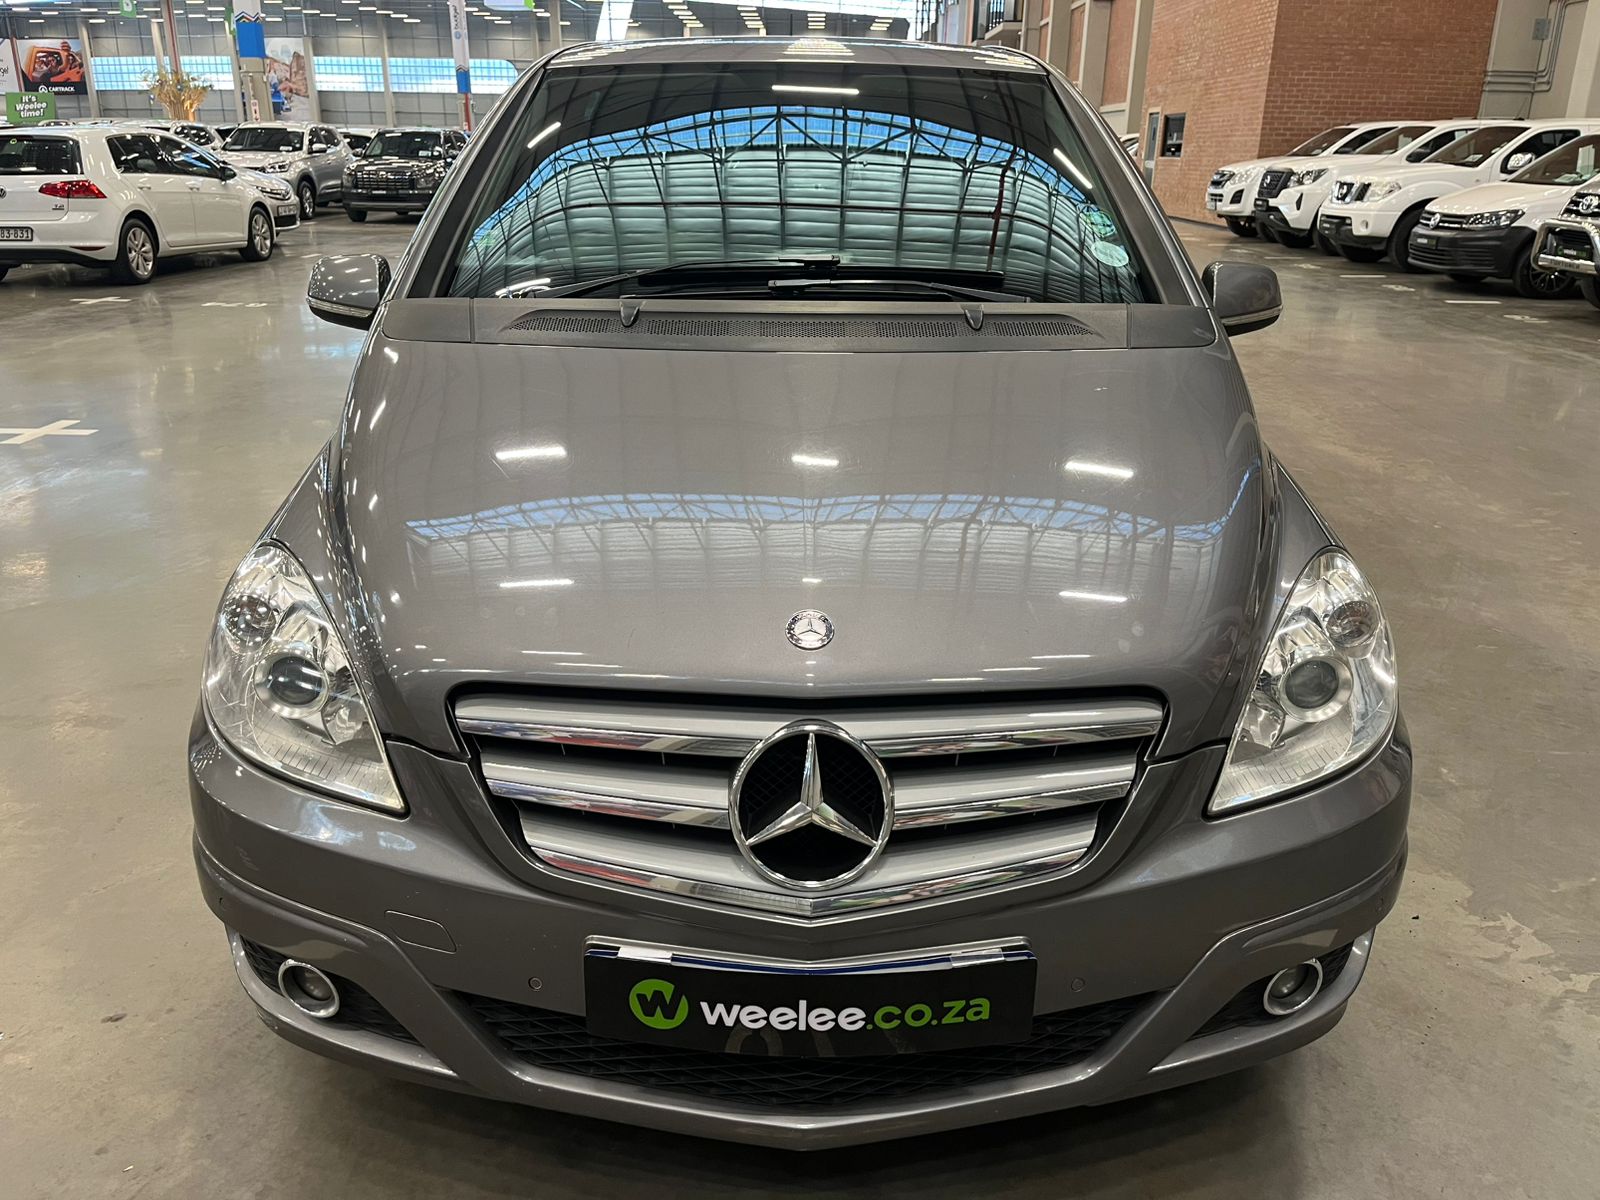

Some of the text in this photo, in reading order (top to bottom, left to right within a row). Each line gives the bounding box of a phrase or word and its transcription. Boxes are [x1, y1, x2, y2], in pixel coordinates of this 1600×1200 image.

[22, 95, 37, 103] It's
[15, 102, 47, 111] Weelee
[20, 109, 44, 118] time!
[699, 997, 991, 1032] weelee.co.za
